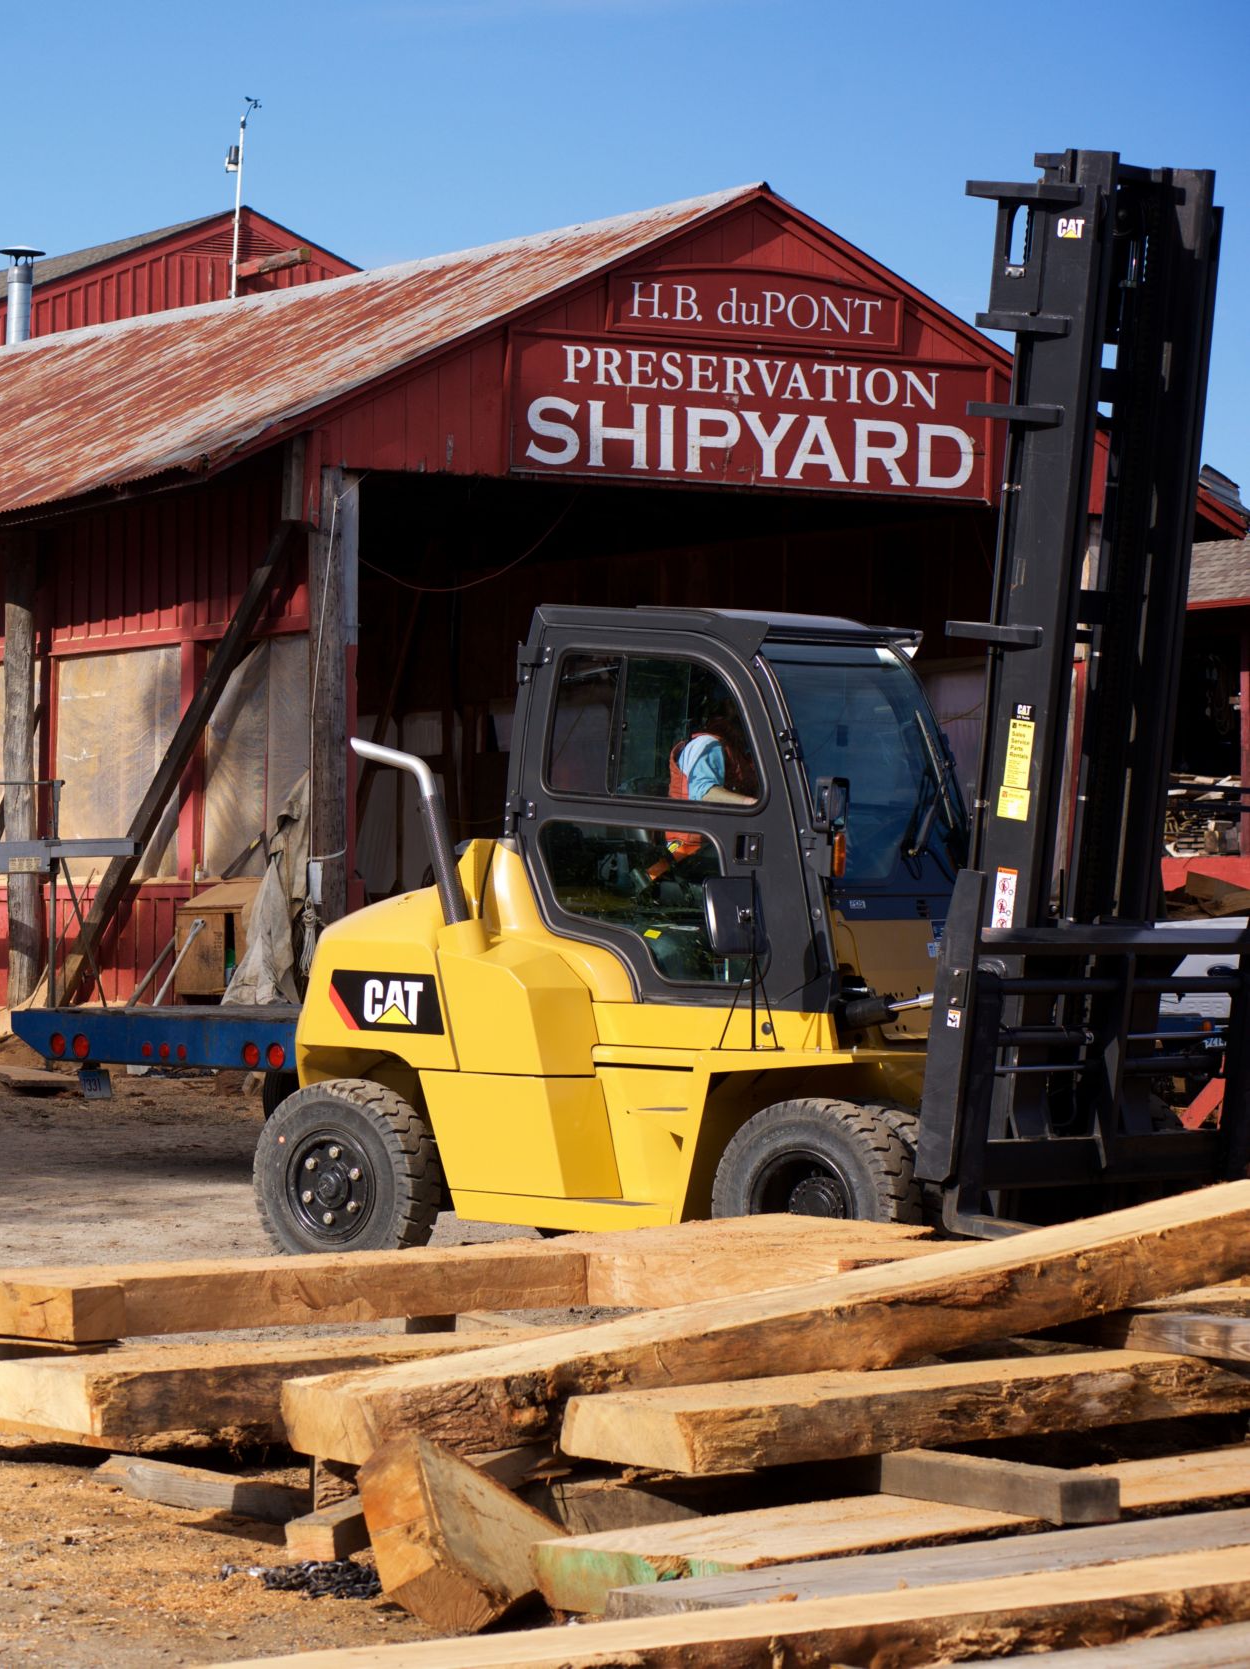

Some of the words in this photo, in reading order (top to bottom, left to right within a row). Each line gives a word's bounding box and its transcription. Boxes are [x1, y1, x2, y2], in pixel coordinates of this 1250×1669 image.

[1057, 217, 1085, 239] CAT
[628, 281, 703, 322] H.B.
[716, 287, 882, 335] duPONT
[562, 345, 939, 410] PRESERVATION
[525, 396, 974, 489] SHIPYARD
[1017, 704, 1032, 716] CAT
[363, 979, 424, 1026] CAT
